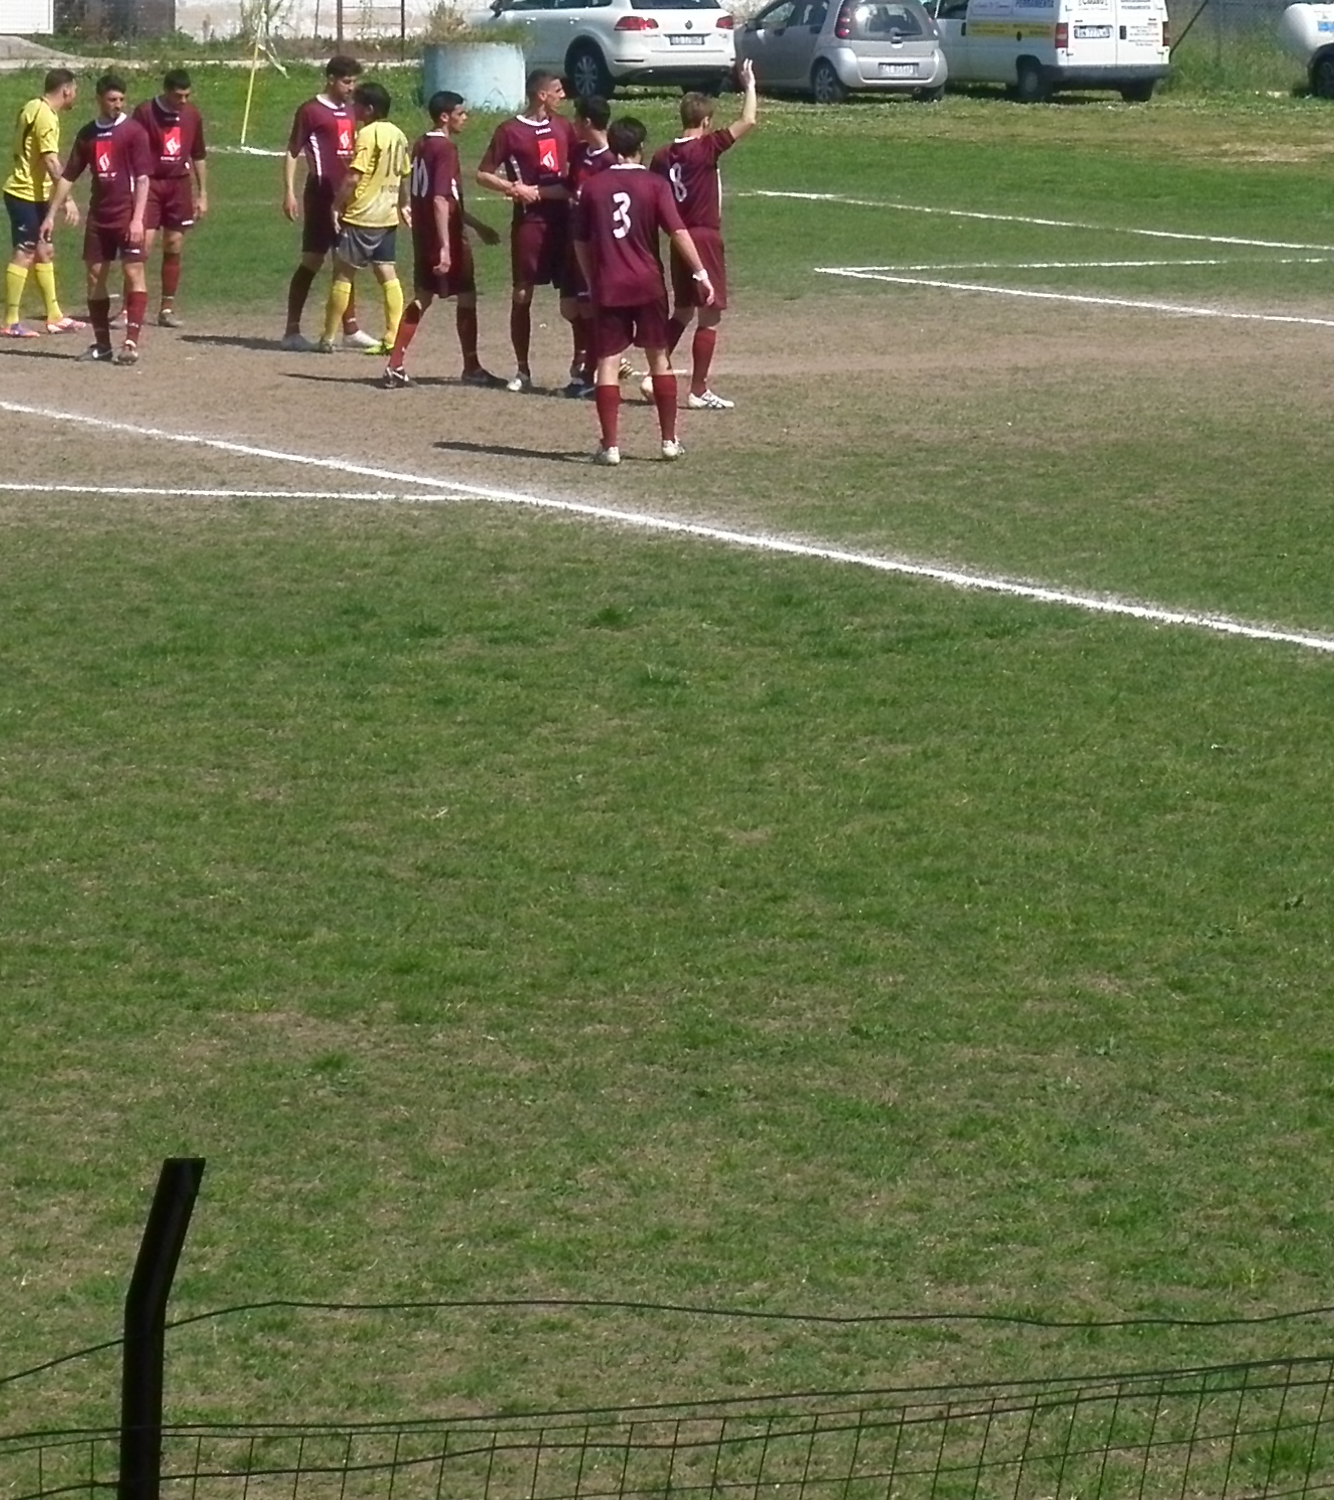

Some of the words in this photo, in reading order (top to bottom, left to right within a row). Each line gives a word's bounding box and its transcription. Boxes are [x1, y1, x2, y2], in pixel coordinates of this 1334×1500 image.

[385, 138, 406, 177] 10
[411, 156, 429, 197] 10
[670, 162, 687, 202] 8
[612, 191, 632, 239] 3
